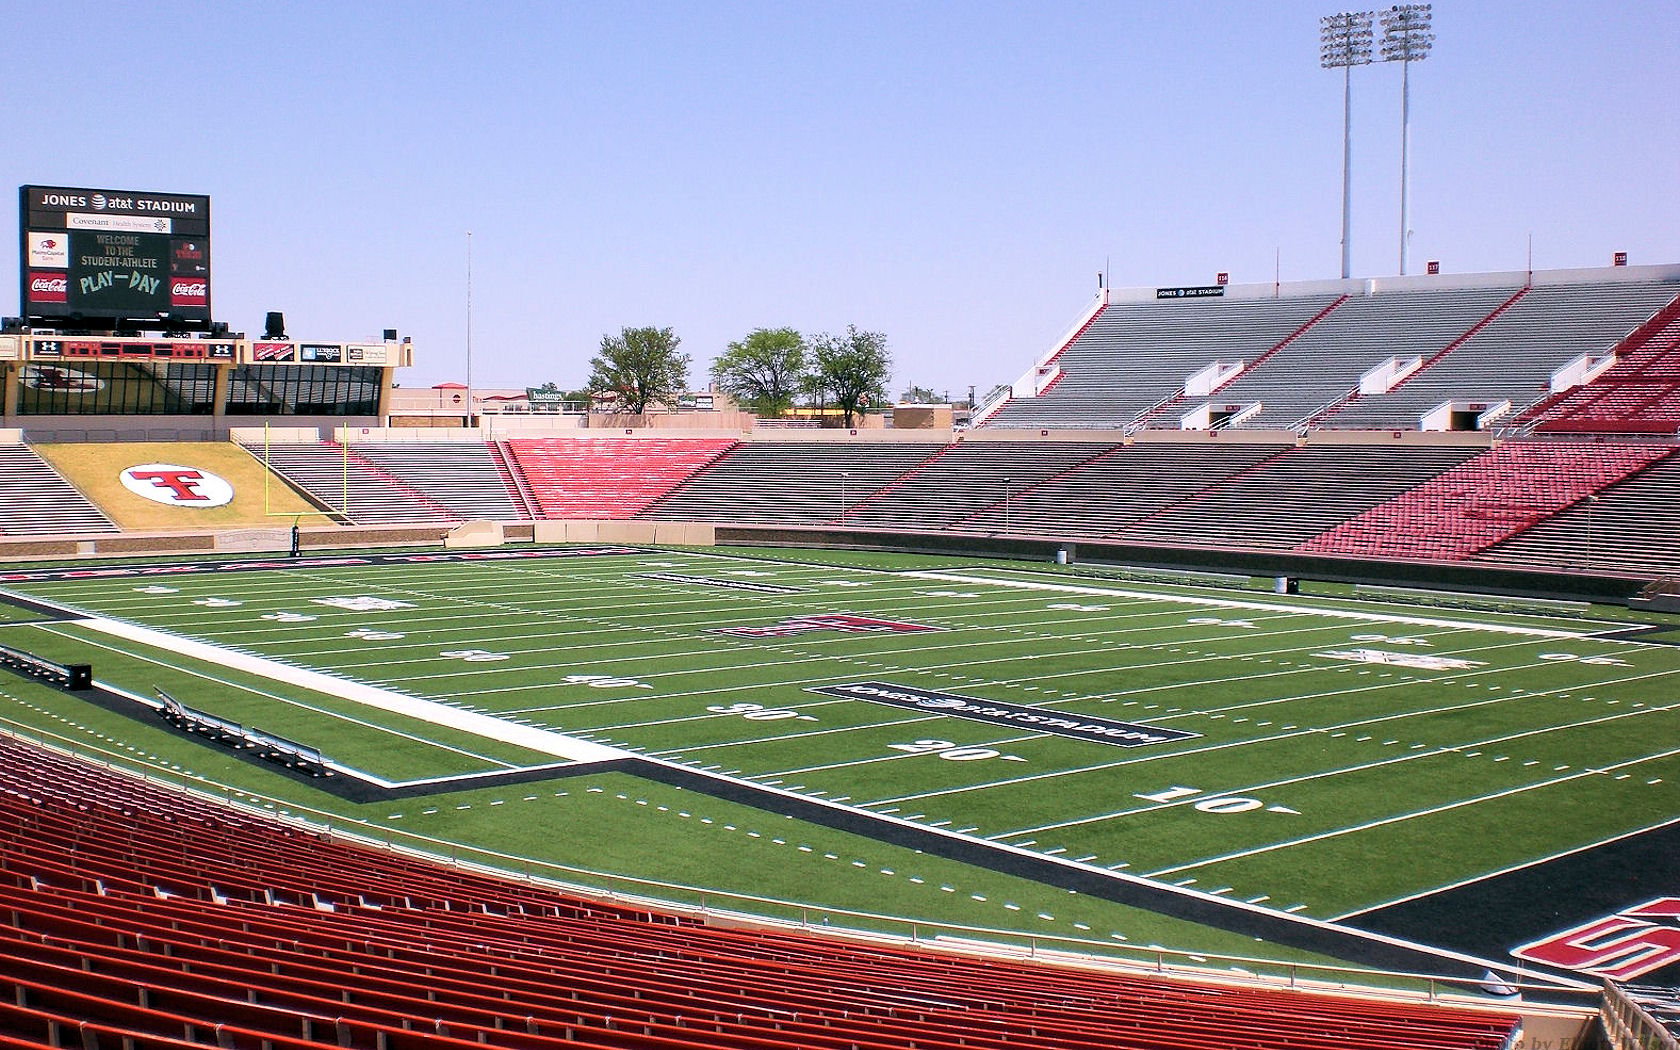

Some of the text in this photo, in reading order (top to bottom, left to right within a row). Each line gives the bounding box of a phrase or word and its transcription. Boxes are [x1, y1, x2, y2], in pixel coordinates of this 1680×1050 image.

[42, 194, 195, 213] JONES at&t STADIUM
[72, 216, 109, 226] Covenant
[96, 235, 140, 246] WELCOME
[81, 256, 157, 268] STUDENT-ATHLETE
[706, 703, 799, 722] 30
[836, 685, 930, 704] JONES
[1019, 713, 1168, 743] STADIUM
[887, 738, 1000, 762] 20
[1132, 786, 1265, 814] 10
